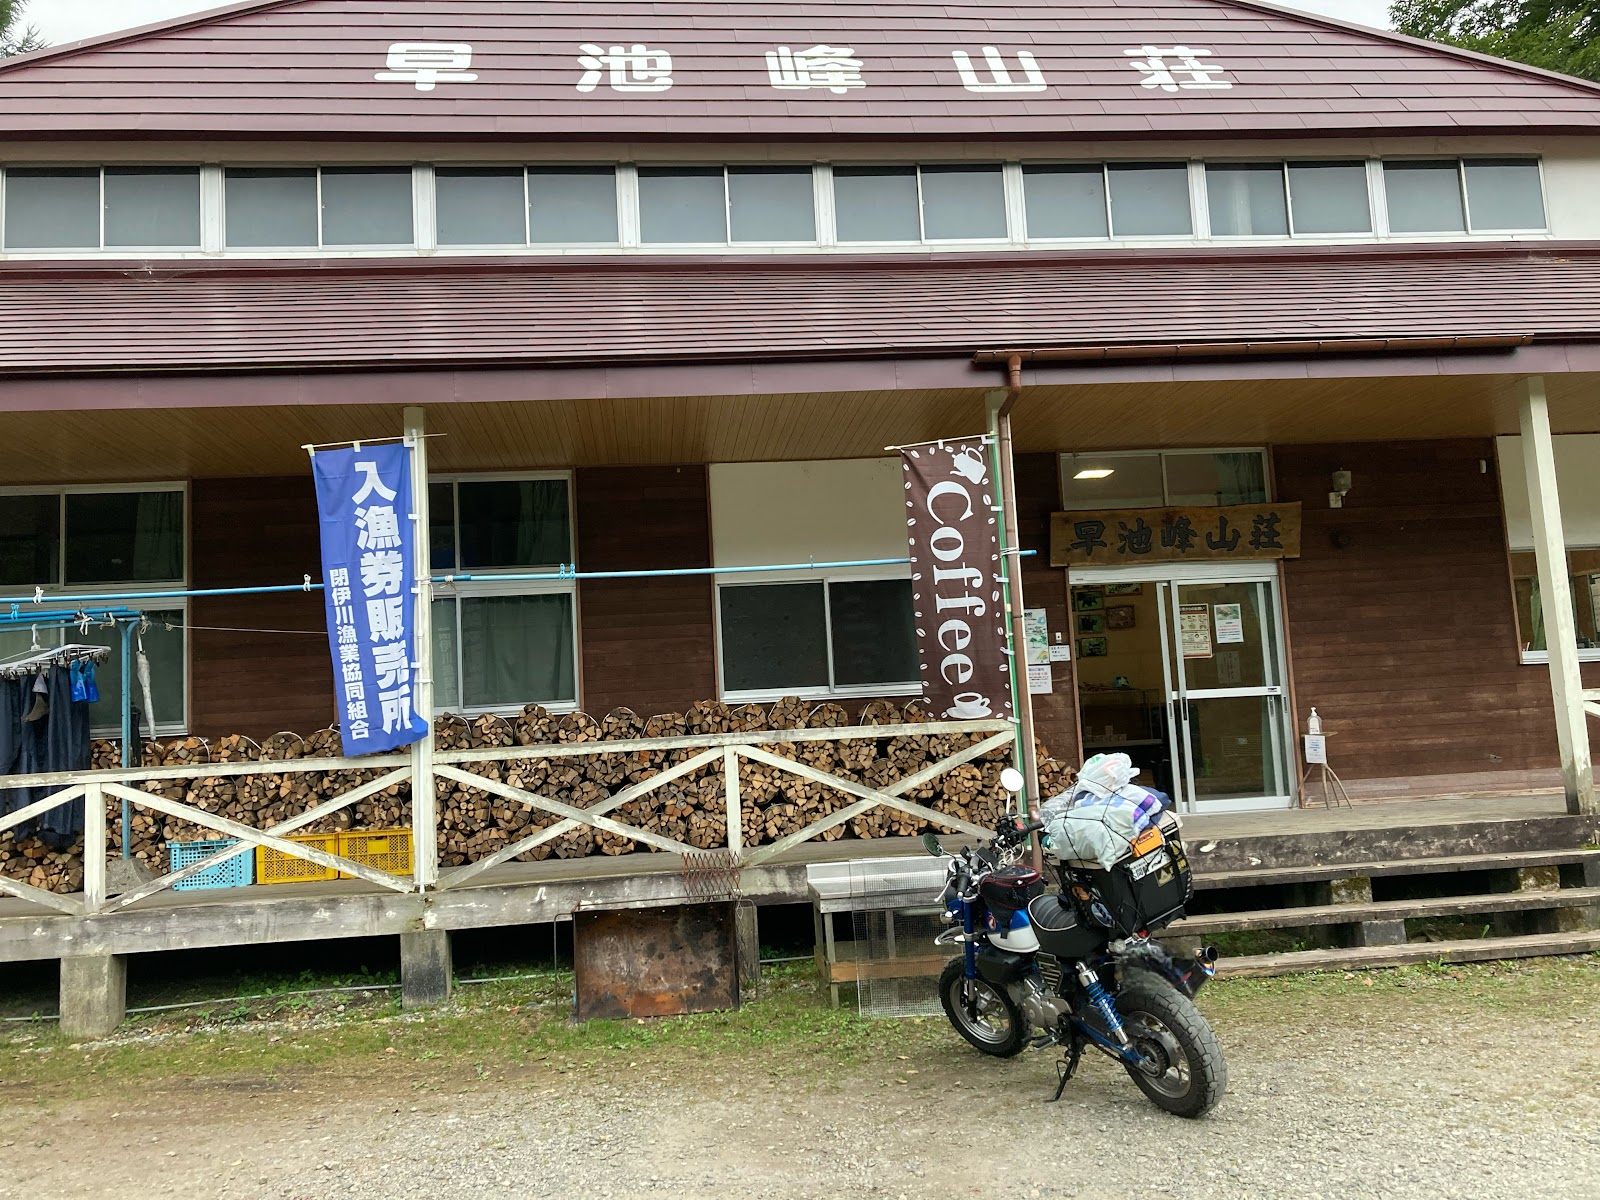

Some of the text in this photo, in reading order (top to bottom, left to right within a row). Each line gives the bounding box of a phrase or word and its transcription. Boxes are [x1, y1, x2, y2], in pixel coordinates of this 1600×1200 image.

[374, 42, 1233, 93] 早池峰山荘
[352, 461, 412, 735] 入漁券販売所
[927, 481, 986, 685] Coffee
[1071, 512, 1284, 556] 早池峰山荘
[329, 568, 369, 741] 閉伊川漁業協同組合
